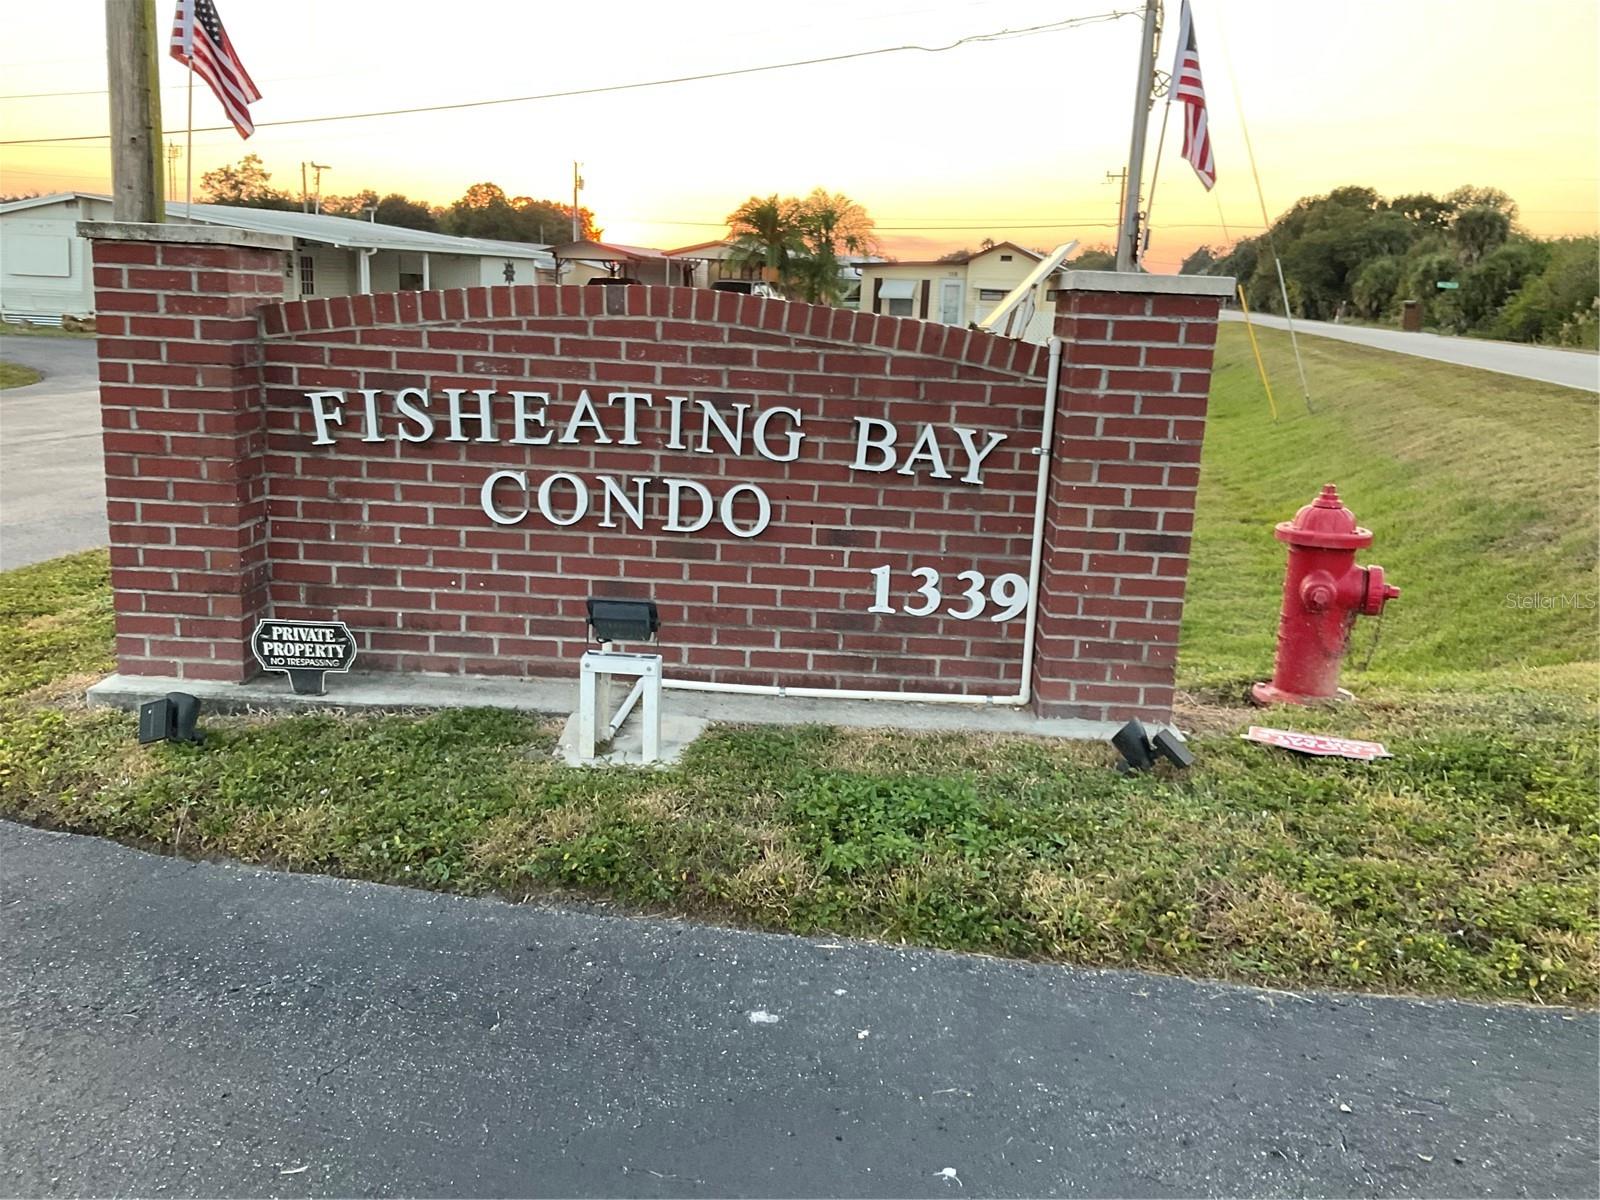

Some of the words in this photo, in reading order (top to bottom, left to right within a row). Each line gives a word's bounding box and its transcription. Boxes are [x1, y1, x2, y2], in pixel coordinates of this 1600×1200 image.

[304, 387, 806, 462] FISHEATING
[849, 416, 1008, 484] BAY
[481, 470, 772, 538] CONDO
[867, 564, 1029, 622] 1339
[262, 641, 346, 658] PROPERTY
[271, 626, 335, 643] PRIVATE
[270, 657, 286, 665] NO
[287, 657, 341, 667] TRESPASSING
